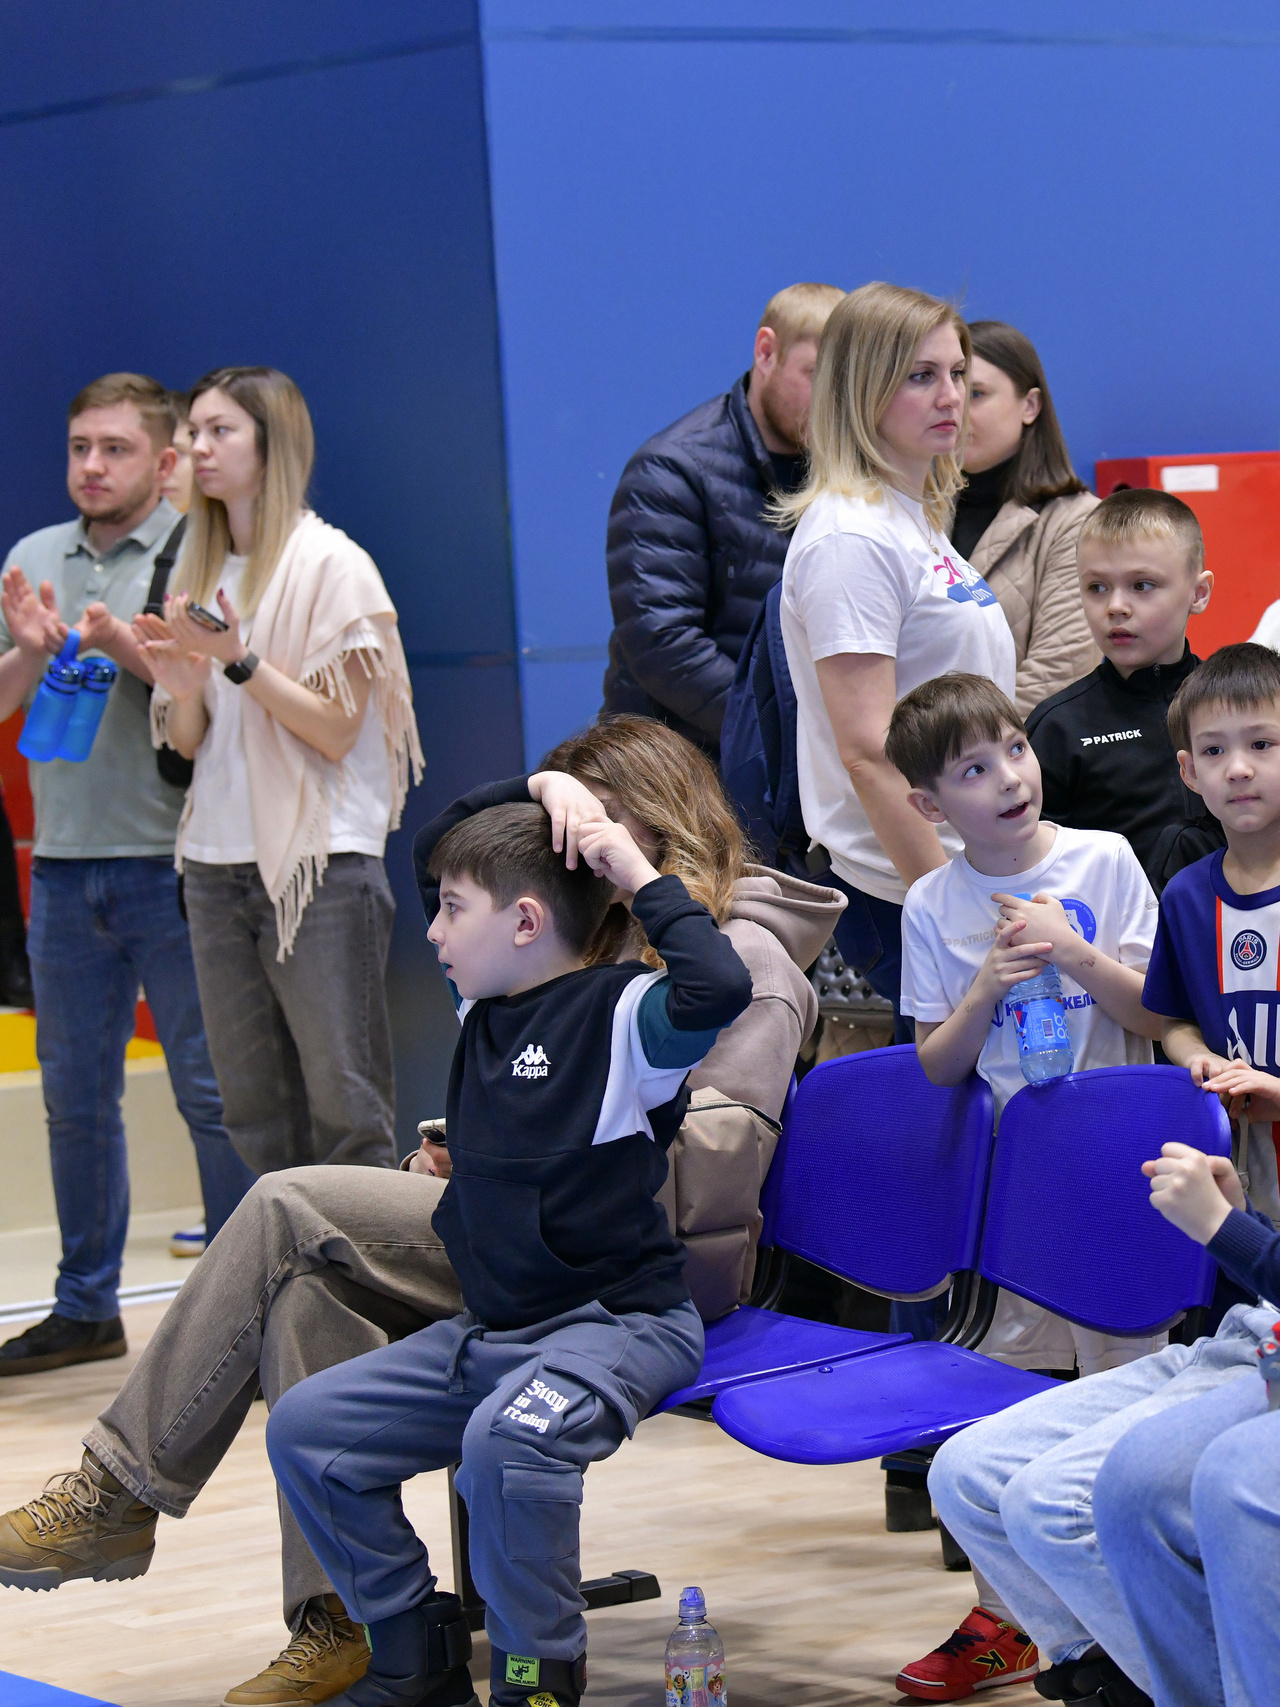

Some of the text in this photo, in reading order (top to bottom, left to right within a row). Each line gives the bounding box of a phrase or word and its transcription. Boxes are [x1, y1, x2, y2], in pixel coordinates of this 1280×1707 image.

[1093, 729, 1142, 745] PATRICK
[1238, 935, 1259, 945] PARIS
[512, 1064, 548, 1079] Kappa
[513, 1393, 532, 1408] in
[525, 1379, 569, 1413] Stay
[503, 1406, 550, 1434] reality
[510, 1656, 536, 1665] WARNING
[536, 1695, 554, 1705] SAFE
